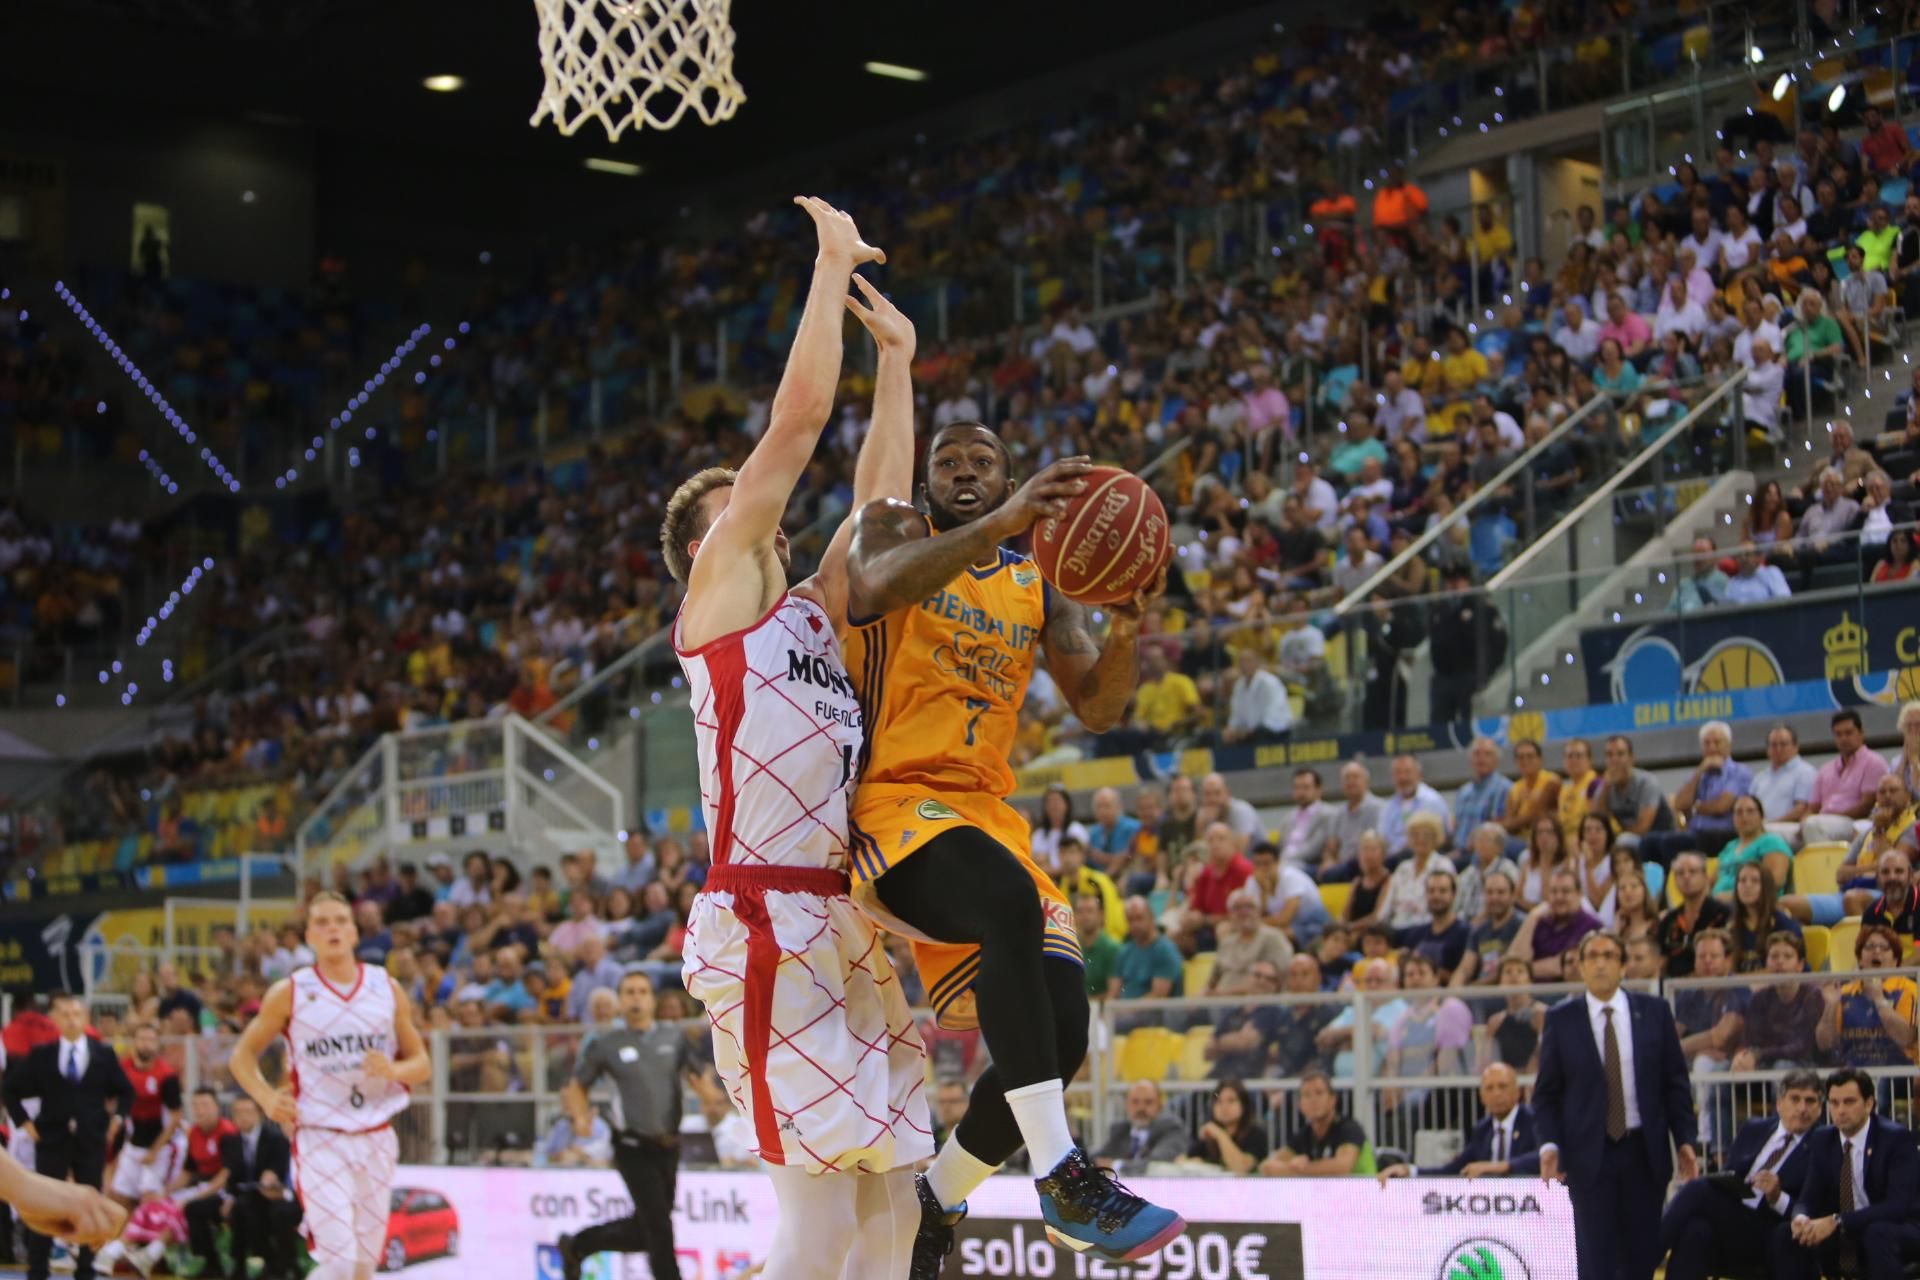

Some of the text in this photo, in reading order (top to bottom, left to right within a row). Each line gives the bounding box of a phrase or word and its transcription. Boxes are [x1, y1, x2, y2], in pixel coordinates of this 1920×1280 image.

[1064, 487, 1131, 576] SPALDING
[965, 695, 992, 747] 7
[304, 1033, 387, 1058] MONTAK
[350, 1083, 364, 1109] 6
[530, 1192, 578, 1219] con
[1422, 1188, 1543, 1216] ŠKODA
[960, 1223, 1056, 1279] solo
